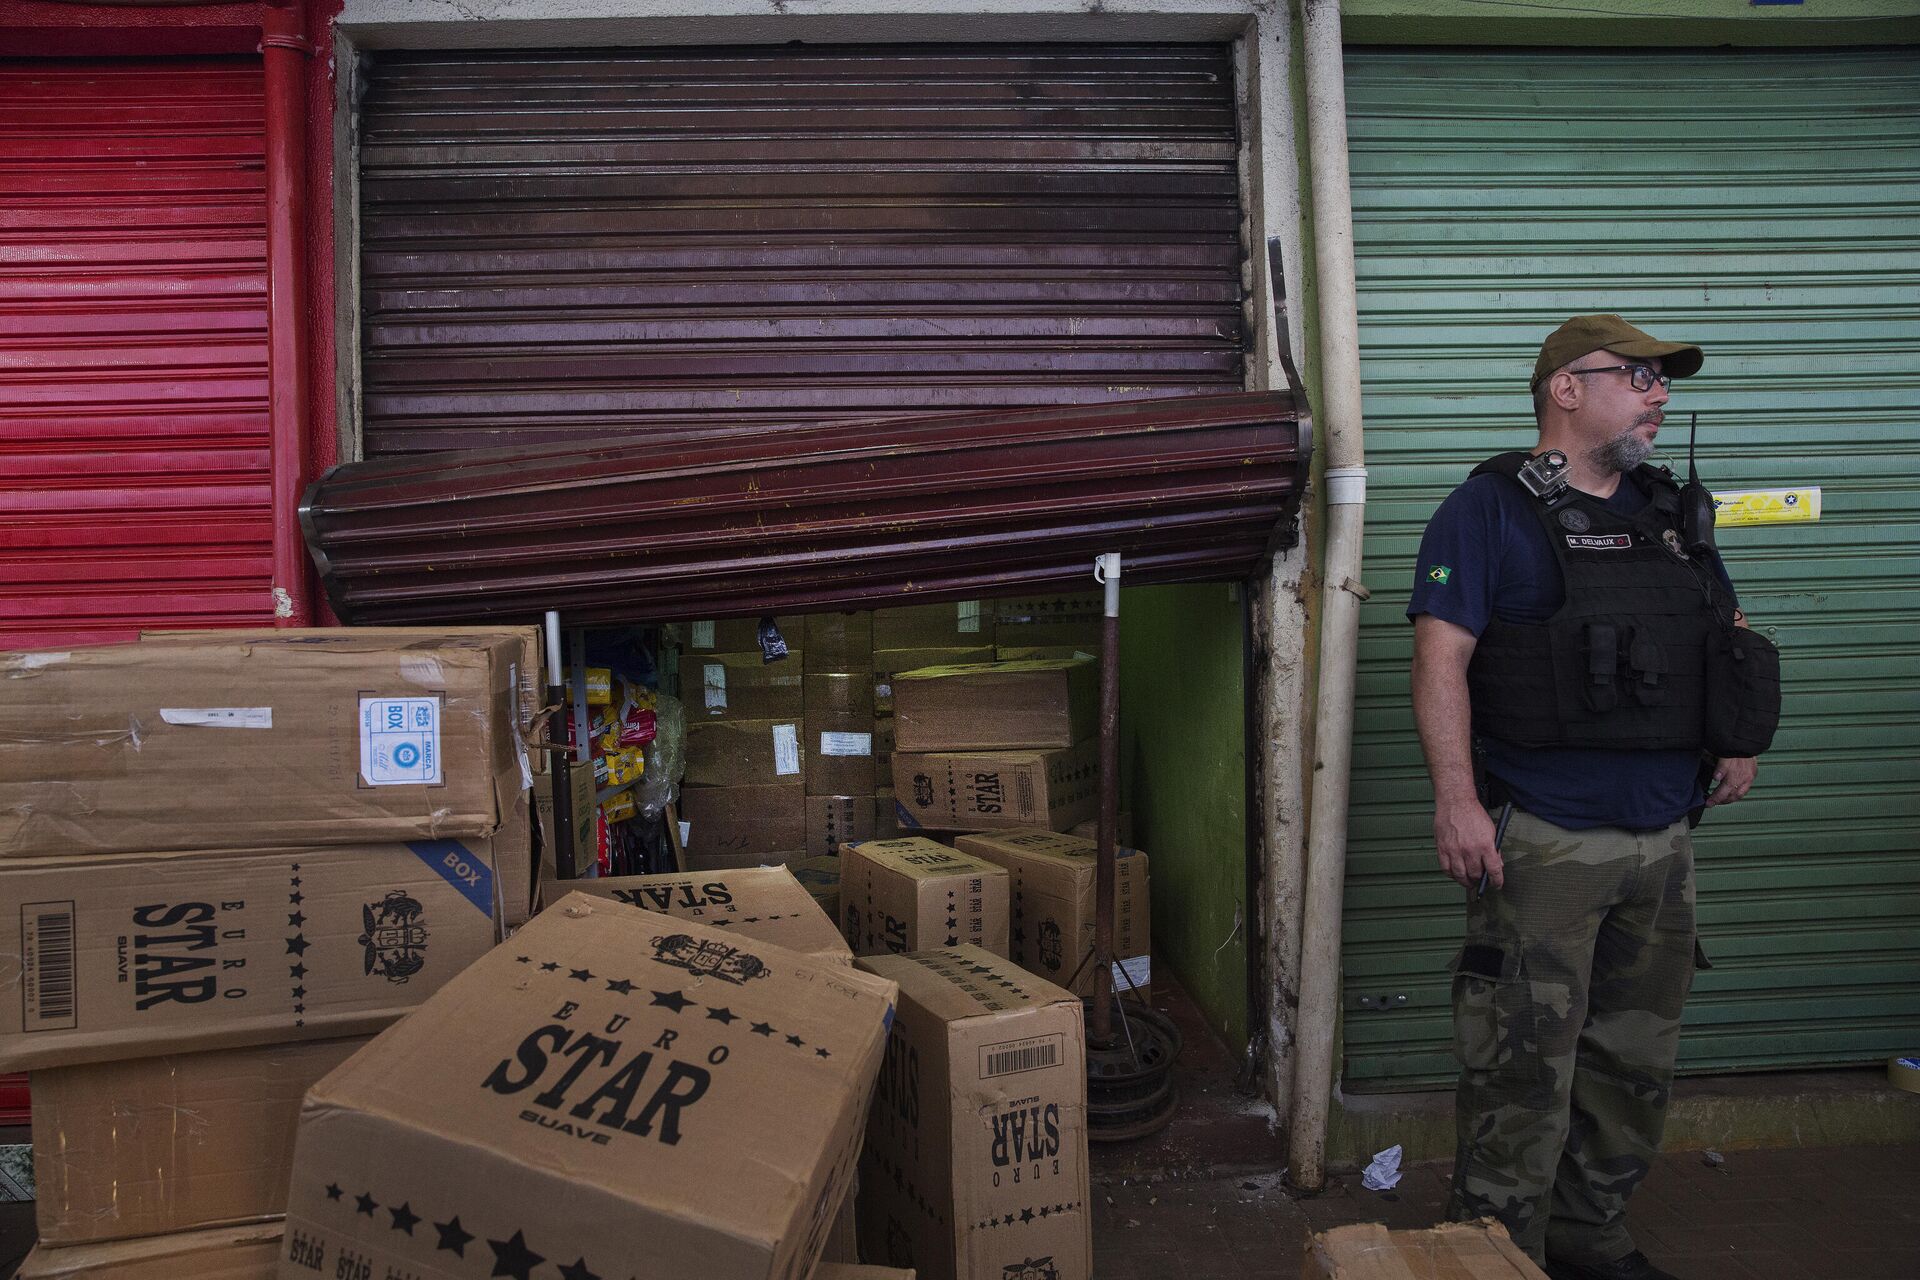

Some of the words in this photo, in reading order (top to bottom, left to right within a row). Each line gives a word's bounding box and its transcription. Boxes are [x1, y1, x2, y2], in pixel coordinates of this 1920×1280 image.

[1581, 538, 1615, 546] DELVAUX
[388, 706, 403, 729] BOX
[965, 773, 976, 812] EURO
[975, 773, 1002, 814] STAR
[443, 851, 483, 888] BOX
[905, 854, 959, 864] STAR
[117, 936, 128, 983] SUAVE
[133, 902, 217, 1011] STAR
[221, 900, 247, 999] EURO
[553, 1000, 730, 1066] EURO
[481, 1024, 712, 1146] STAR
[1008, 1095, 1040, 1107] SUAVE
[518, 1109, 612, 1146] SUAVE
[991, 1102, 1060, 1167] STAR
[993, 1159, 1060, 1188] EURO
[290, 1237, 325, 1272] STAR
[337, 1255, 372, 1280] STAR
